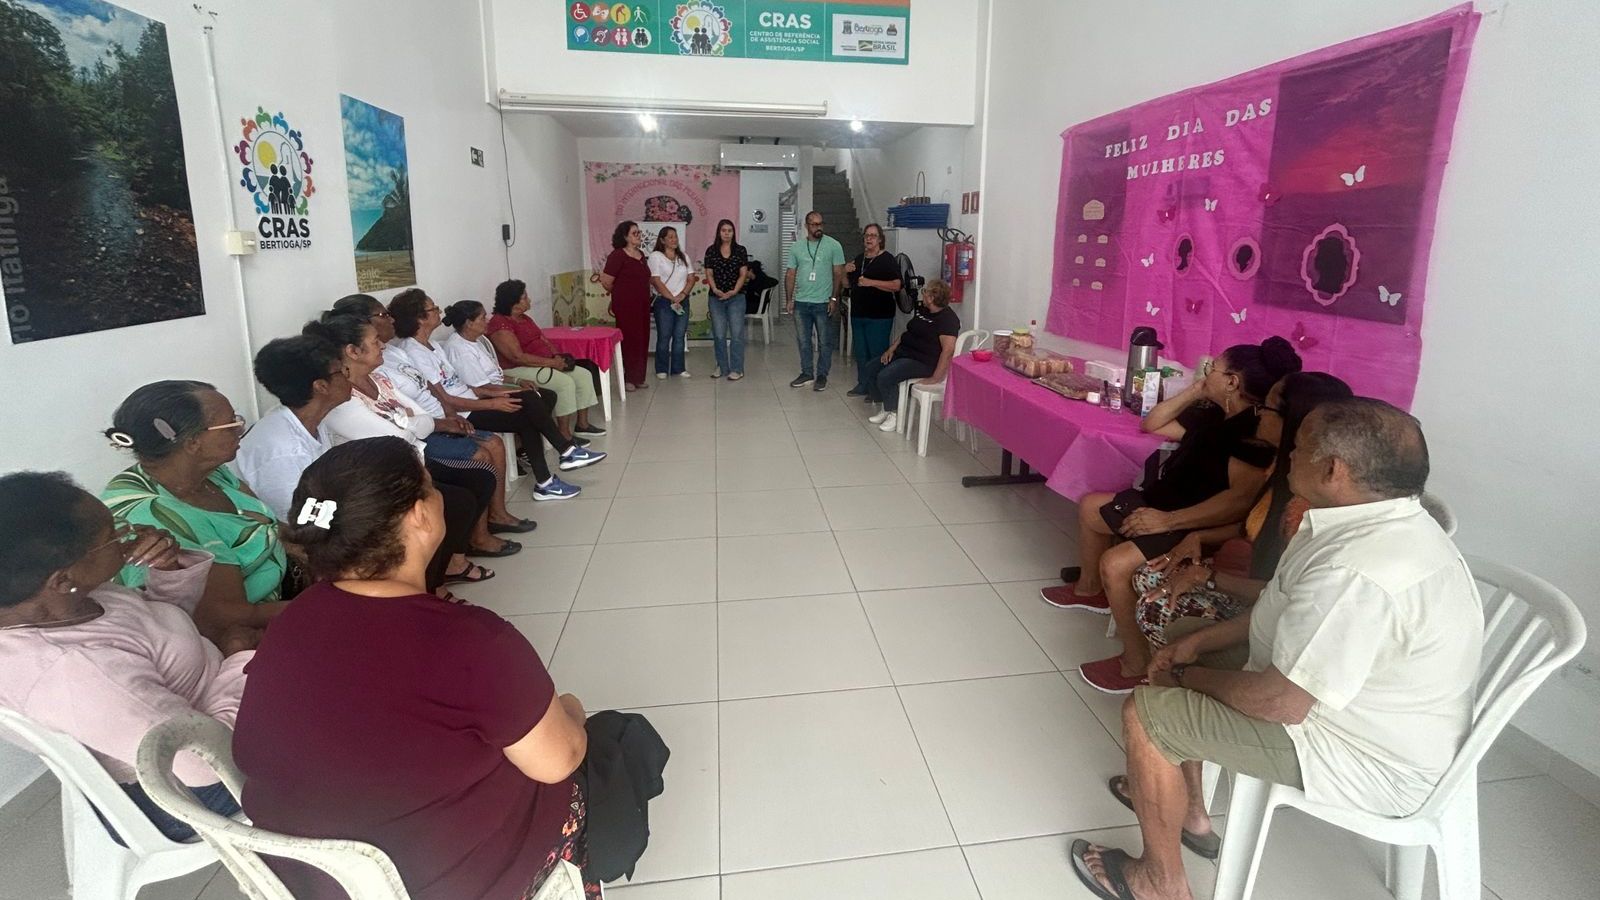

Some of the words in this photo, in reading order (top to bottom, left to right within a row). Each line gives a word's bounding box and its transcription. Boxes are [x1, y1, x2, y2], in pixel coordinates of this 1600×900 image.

[759, 11, 812, 29] CRAS
[1104, 135, 1149, 159] FELIZ
[1166, 117, 1204, 141] DIA
[1225, 98, 1272, 127] DAS
[1126, 149, 1225, 180] MULHERES
[258, 216, 310, 238] CRAS
[260, 240, 312, 250] BERTIOGA/SP
